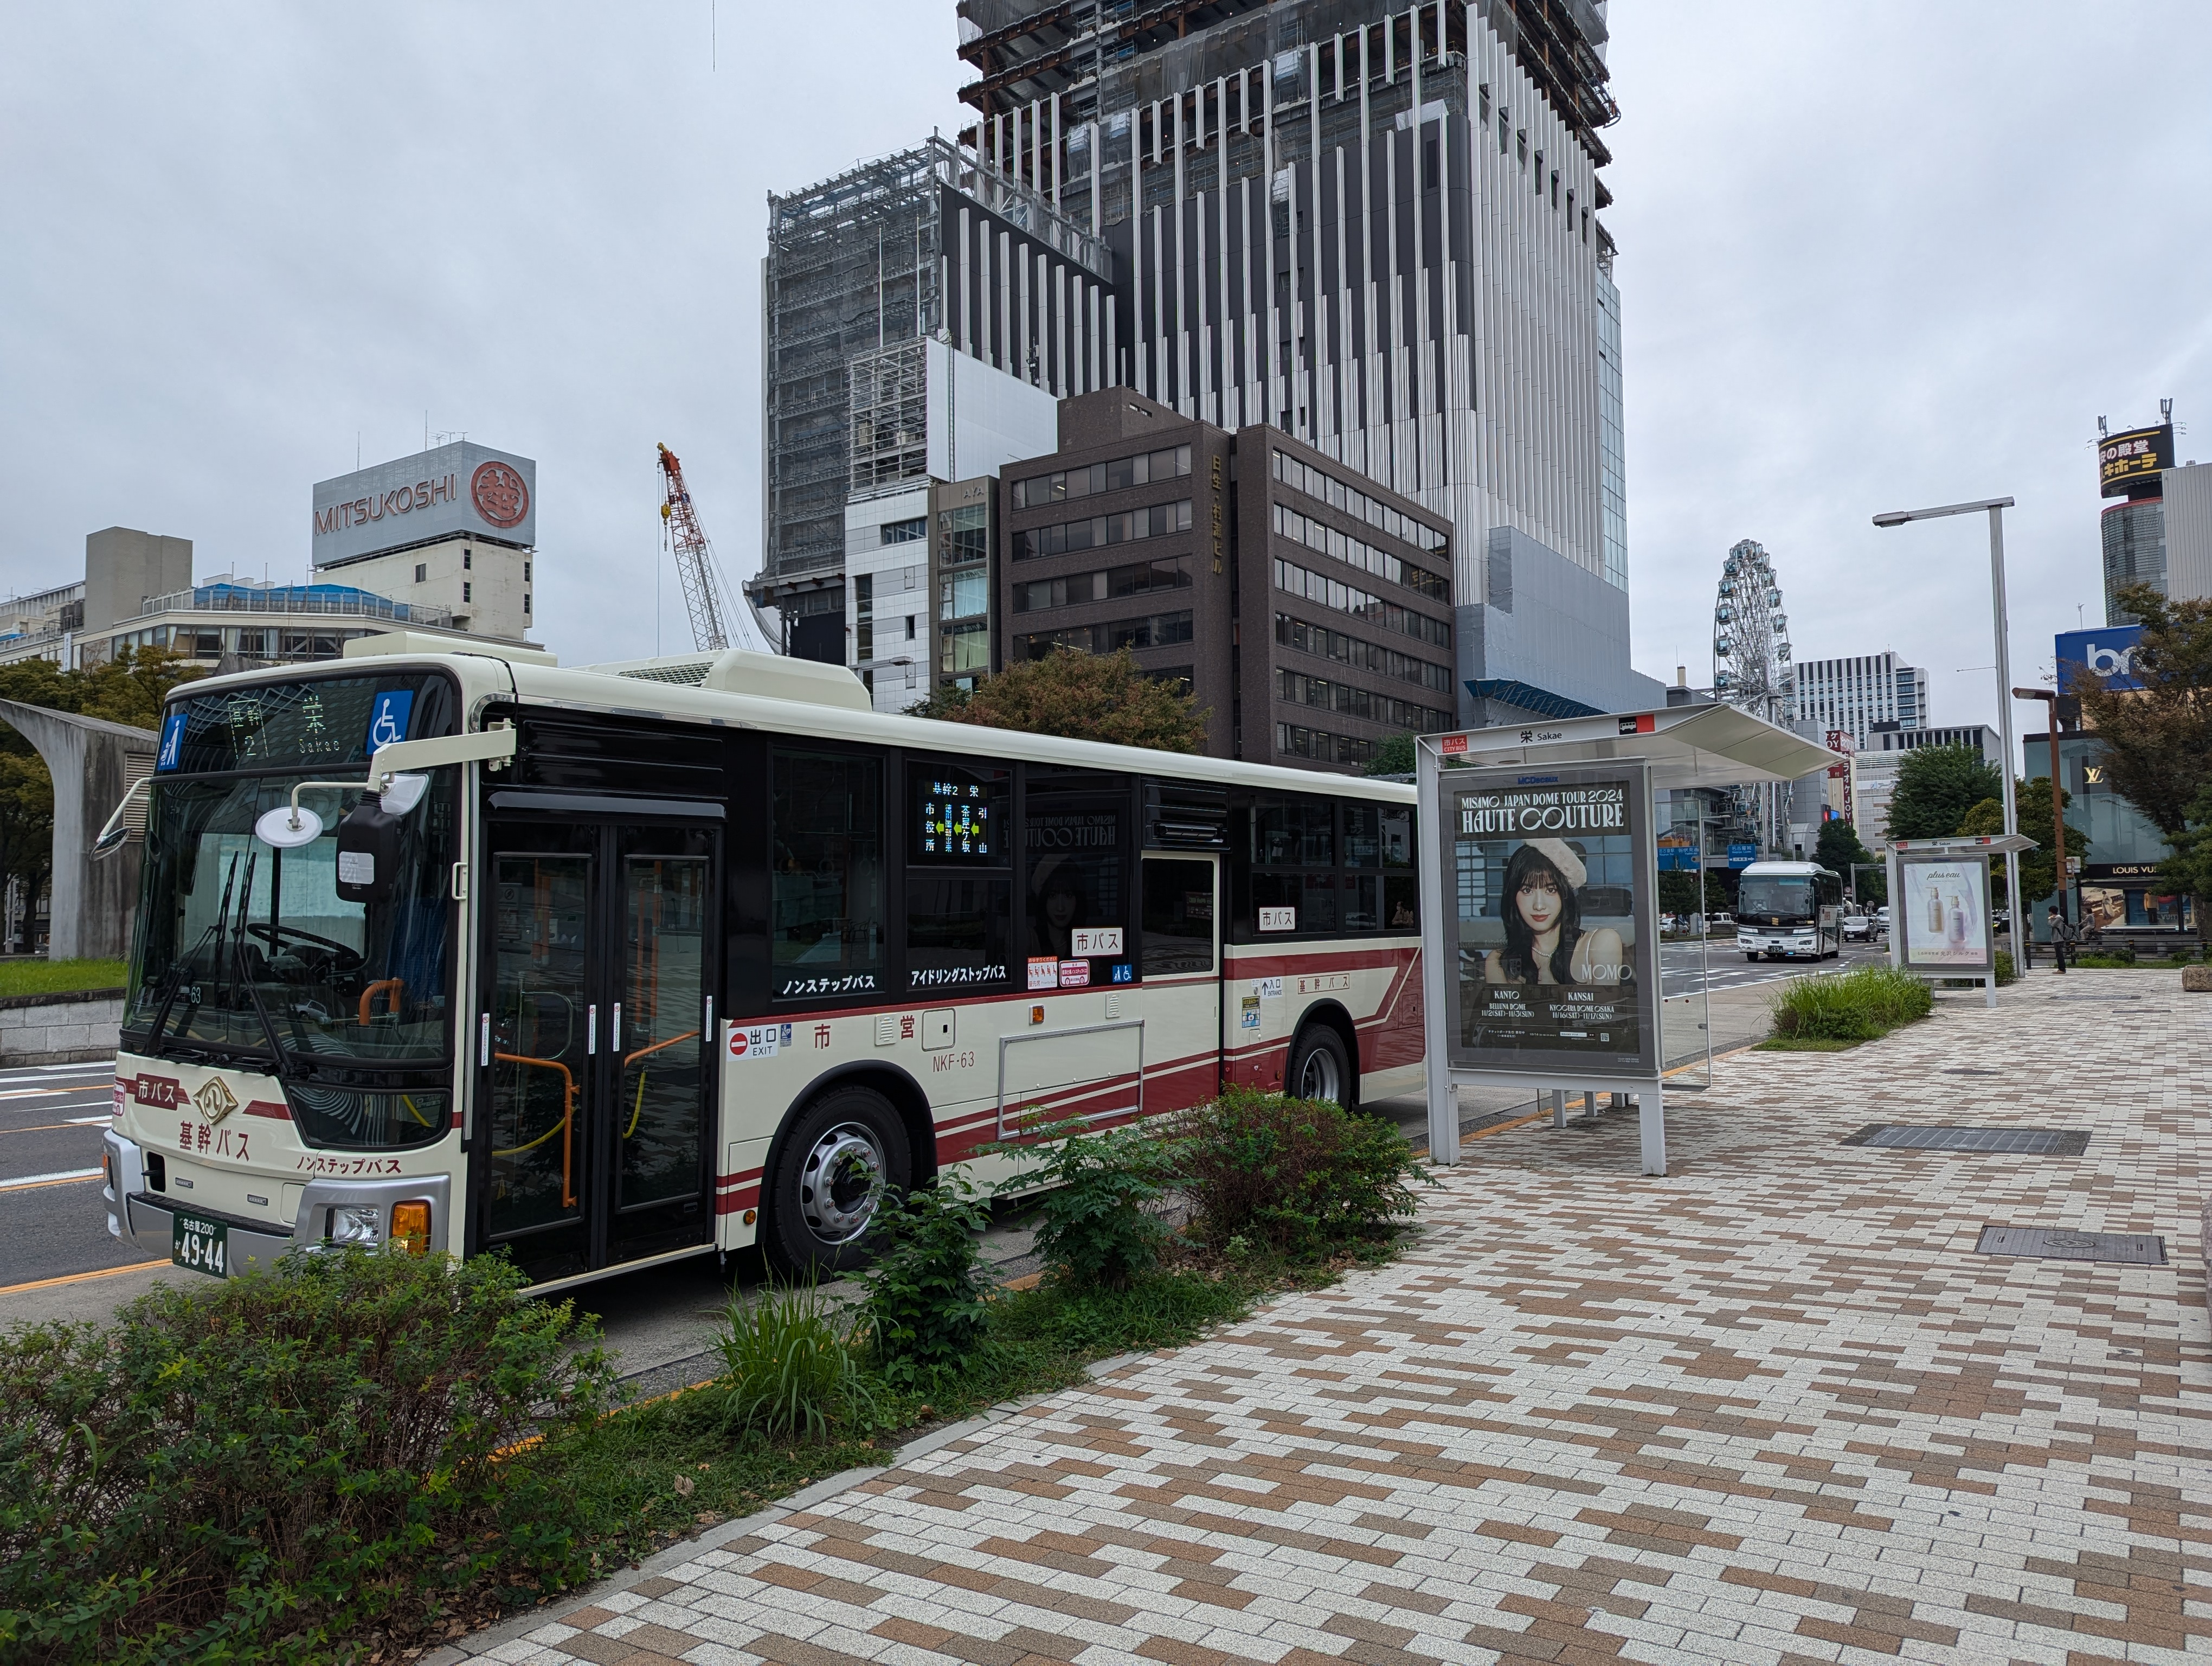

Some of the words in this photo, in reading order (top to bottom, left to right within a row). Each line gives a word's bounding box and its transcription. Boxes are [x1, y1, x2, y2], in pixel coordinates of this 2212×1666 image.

[964, 486, 984, 498] AYA
[314, 473, 457, 536] MITSUKOSHI
[1444, 738, 1465, 746] 市バス
[1520, 731, 1533, 744] 栄
[1537, 732, 1562, 741] Sakae
[969, 785, 979, 797] 栄
[1462, 796, 1500, 810] MISAMO
[1504, 794, 1531, 806] JAPAN
[1533, 792, 1559, 805] DOME
[1560, 791, 1586, 804] TOUR
[1588, 789, 1624, 803] 2024
[1462, 809, 1516, 834] HAUTE
[1520, 803, 1624, 830] COUTURE
[1927, 870, 1945, 880] plus
[1262, 911, 1292, 927] 市バス
[1076, 933, 1118, 952] 市バス
[911, 965, 1006, 986] アイドリングストップバス
[1581, 964, 1632, 980] MOMO
[783, 975, 875, 995] ノンステップバス
[1270, 979, 1281, 989] 入口
[191, 985, 201, 1004] 63
[1494, 991, 1520, 999] KANTO
[1568, 992, 1594, 1001] KANSAI
[750, 1028, 776, 1045] 出口
[753, 1046, 772, 1056] EXIT
[933, 1051, 974, 1073] NKF-63
[139, 1080, 174, 1103] 市バス
[179, 1120, 249, 1162] 基幹バス
[297, 1156, 402, 1175] ノンステップバス
[175, 1240, 181, 1250] か
[182, 1232, 223, 1273] 49-44
